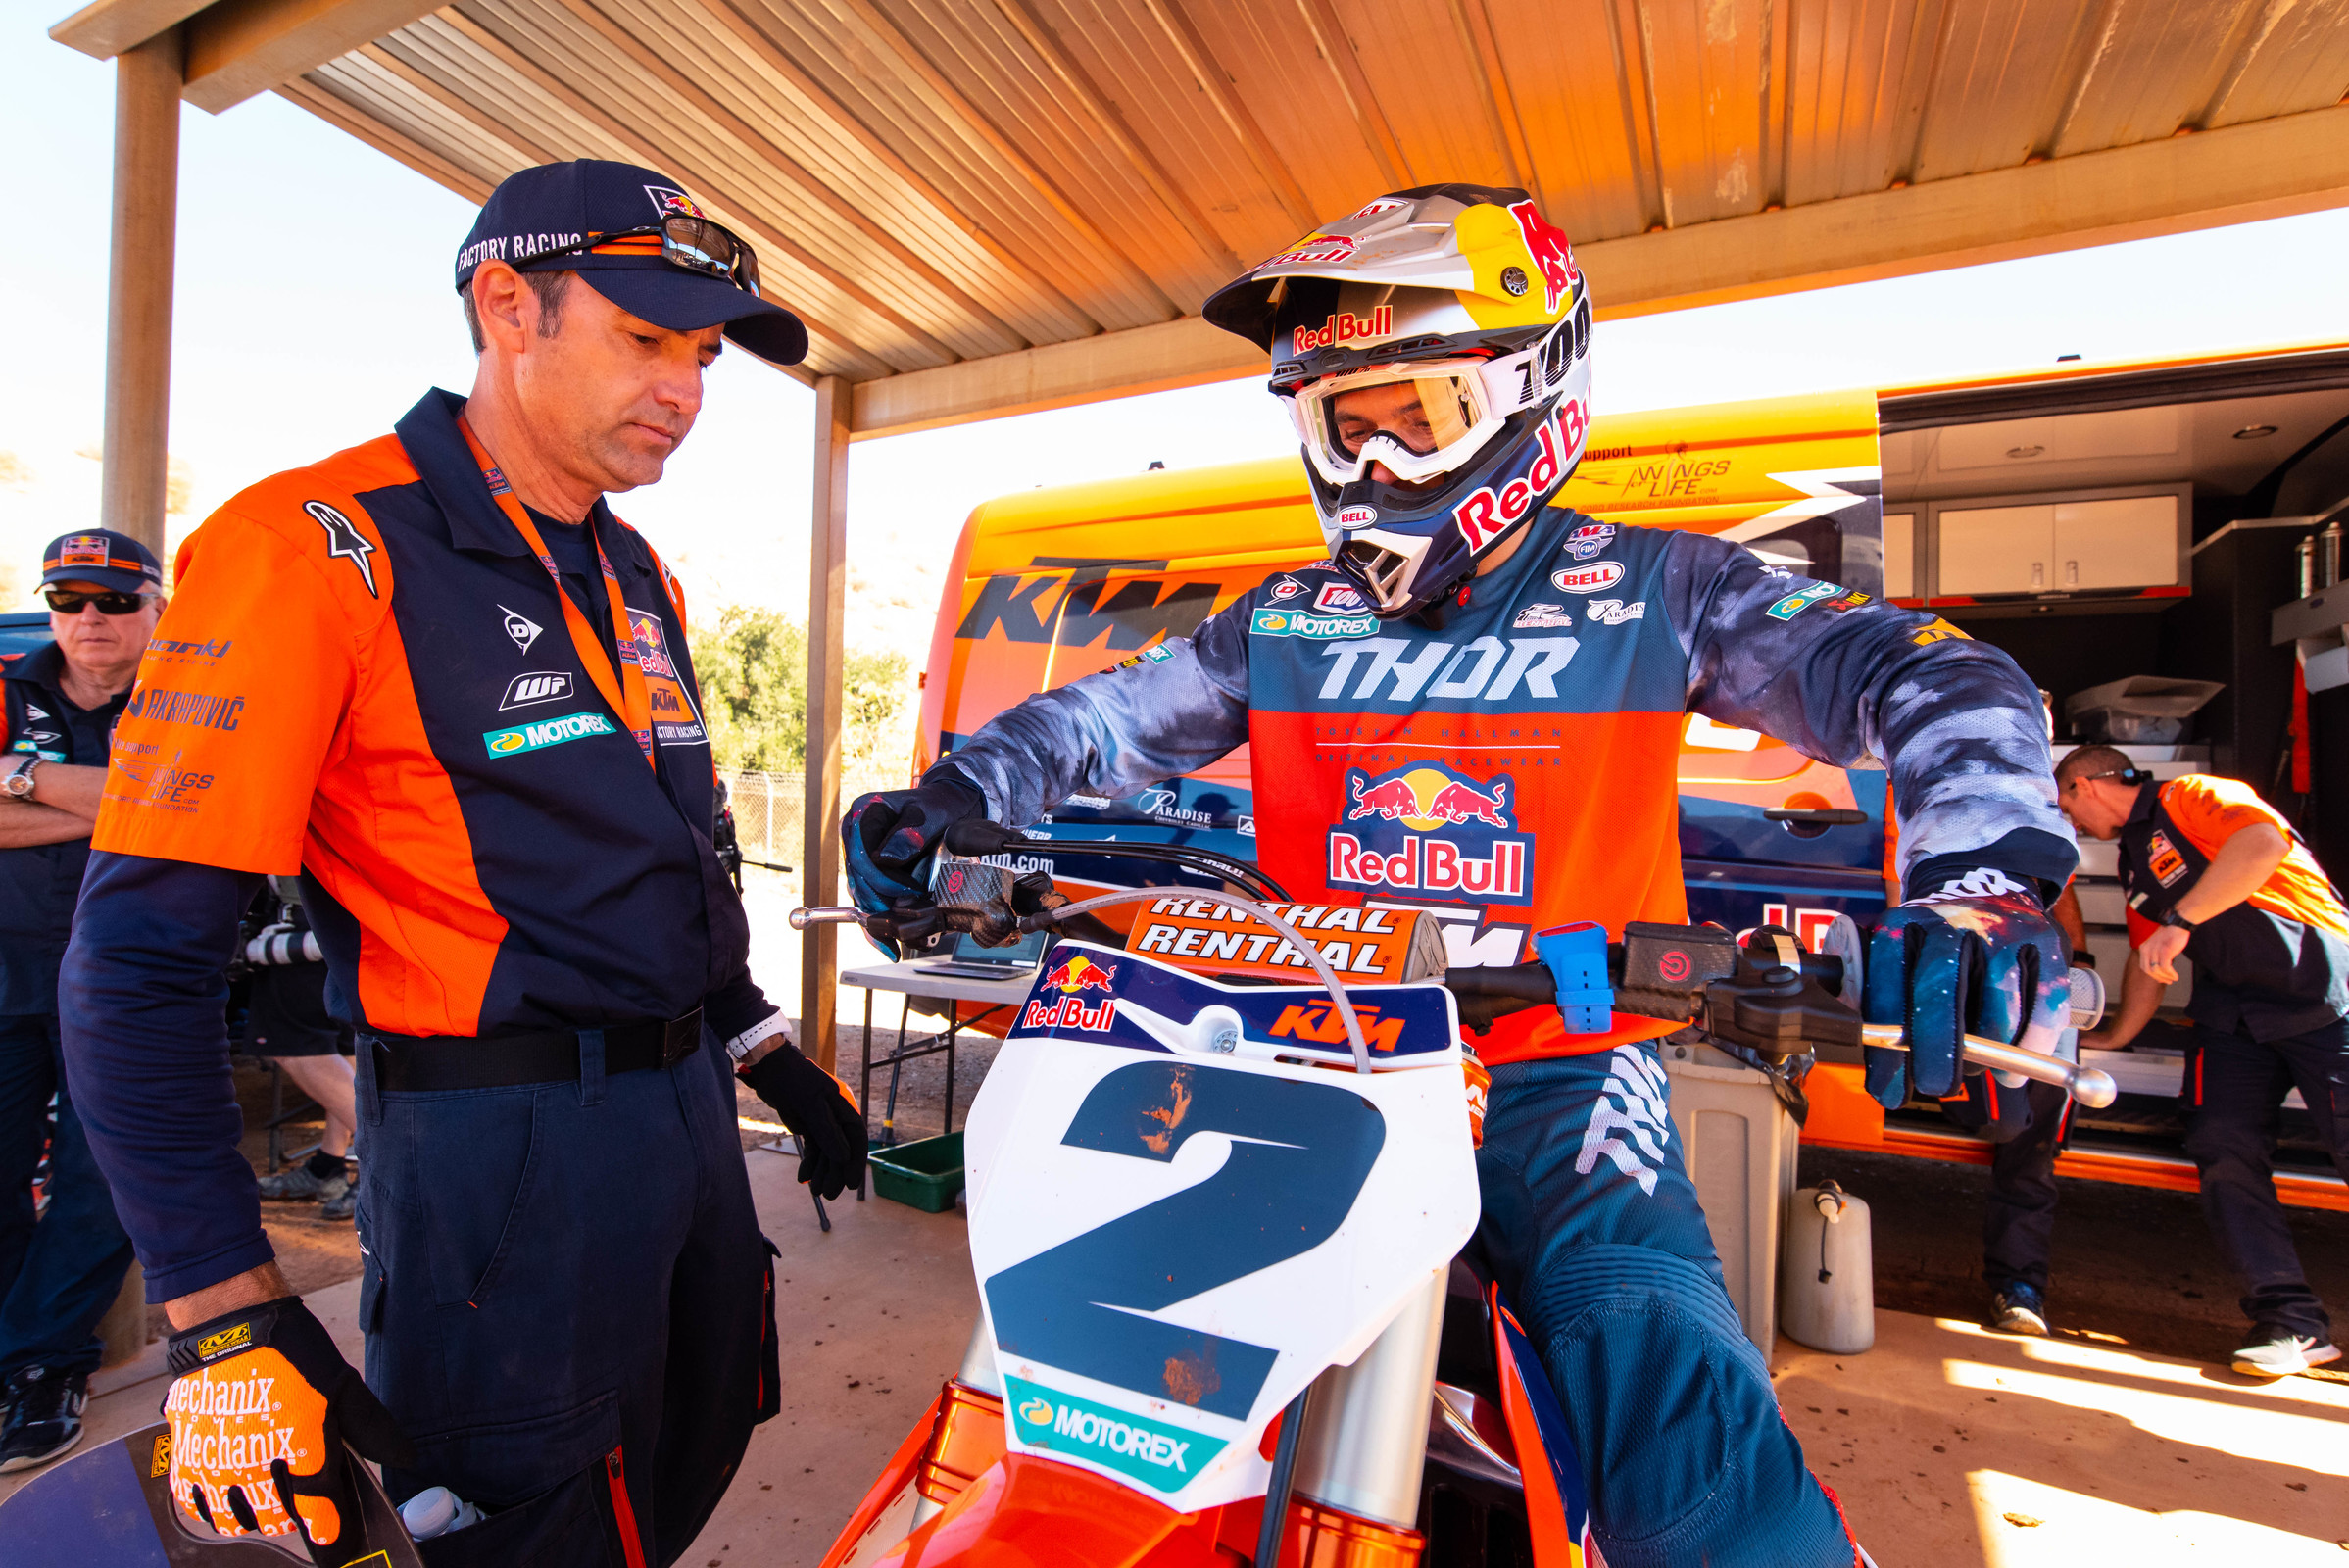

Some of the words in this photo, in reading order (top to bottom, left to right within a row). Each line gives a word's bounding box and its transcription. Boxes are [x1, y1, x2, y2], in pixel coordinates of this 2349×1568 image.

[458, 236, 508, 272] FACTORY
[513, 232, 583, 258] RACING
[1272, 248, 1357, 266] Bull
[1293, 315, 1335, 356] Red
[1335, 305, 1393, 343] Bull
[1453, 421, 1560, 554] Red
[1341, 511, 1370, 523] BELL
[1607, 501, 1656, 511] RESEARCH
[1658, 496, 1720, 508] FOUNDATION
[1580, 544, 1596, 554] FIM
[1563, 568, 1614, 586] BELL
[954, 556, 1222, 652] KTM
[1325, 589, 1364, 607] 100
[1588, 601, 1644, 621] PARADIS
[1290, 613, 1372, 636] MOTOREX
[1318, 636, 1581, 702] THOR
[651, 687, 681, 712] KTM
[527, 715, 612, 747] MOTOREX
[657, 726, 677, 739] CTORY
[676, 724, 703, 738] RACING
[1442, 728, 1561, 738] HALLMAN
[125, 742, 160, 756] support
[1439, 757, 1561, 766] RACEWEAR
[1137, 788, 1212, 824] PARADISE
[1331, 832, 1420, 888] Red
[1423, 838, 1526, 896] Bull
[1137, 923, 1387, 975] RENTHAL
[1021, 998, 1061, 1030] Red
[1060, 997, 1116, 1033] Bull
[1268, 998, 1406, 1053] KTM
[984, 1059, 1387, 1423] 2
[201, 1353, 217, 1362] THE
[216, 1342, 253, 1357] ORIGINAL
[173, 1417, 296, 1470] Mechanix
[1053, 1403, 1190, 1473] MOTOREX
